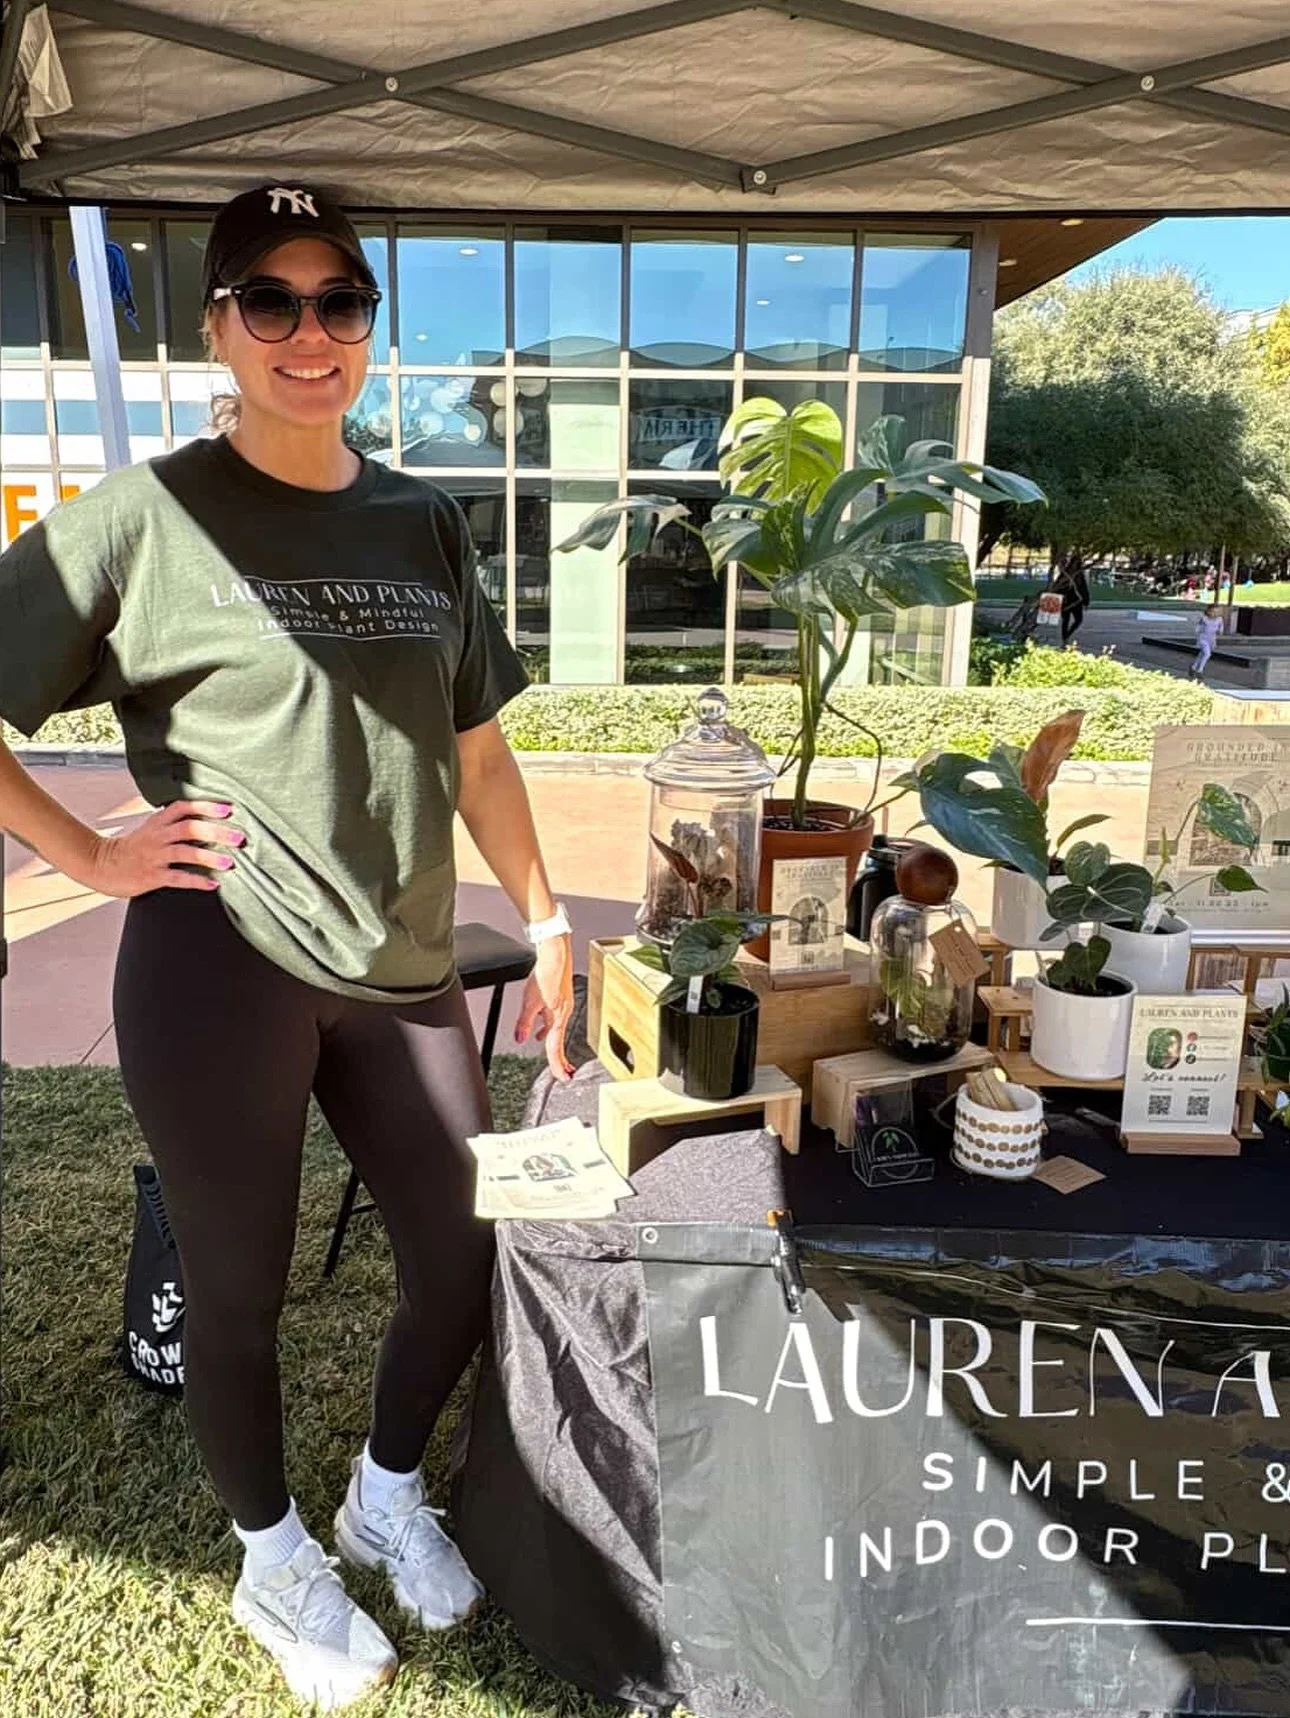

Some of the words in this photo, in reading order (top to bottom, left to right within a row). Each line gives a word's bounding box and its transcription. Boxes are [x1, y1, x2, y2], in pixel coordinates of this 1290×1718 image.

[210, 582, 311, 608] LAUREN
[321, 583, 370, 605] AND
[376, 584, 451, 611] PLANTS
[257, 618, 321, 632] Indoor
[384, 619, 439, 632] Design
[359, 606, 425, 620] Mindful
[1140, 1007, 1177, 1017] LAUREN
[1179, 1008, 1200, 1018] AND
[1203, 1008, 1238, 1018] PLANTS
[700, 1315, 1174, 1424] LAUREN
[922, 1452, 1204, 1500] SIMPLE
[1261, 1462, 1290, 1503] &
[824, 1517, 1140, 1581] INDOOR
